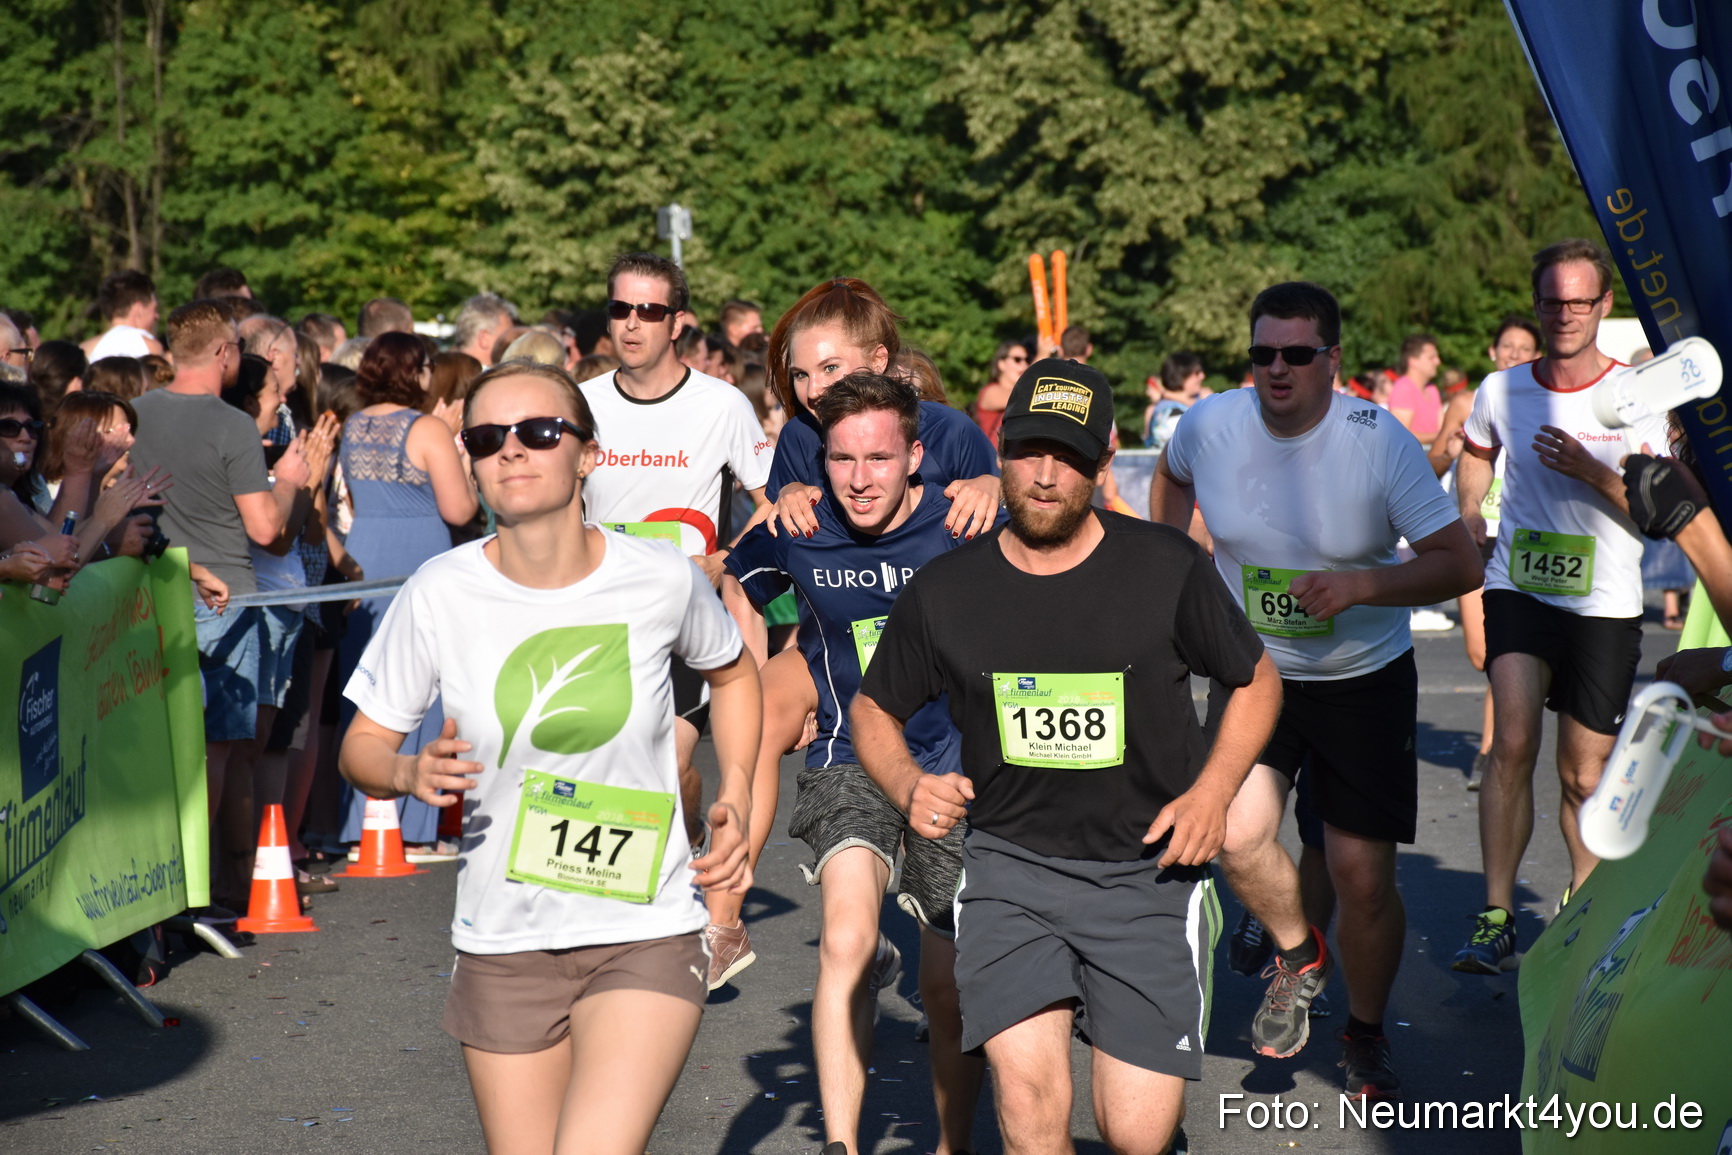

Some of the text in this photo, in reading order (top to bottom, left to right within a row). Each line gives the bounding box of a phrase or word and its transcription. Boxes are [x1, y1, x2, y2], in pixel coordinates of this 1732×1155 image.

[1034, 391, 1089, 405] INDUSTRY
[1054, 384, 1089, 396] EQUIPMENT
[1051, 402, 1086, 414] LEADING
[1346, 413, 1378, 430] adidas
[1577, 431, 1623, 442] Oberbank
[1520, 551, 1583, 578] 1452
[813, 568, 878, 588] EURO
[1283, 618, 1307, 626] Stefan
[1010, 688, 1053, 697] firmenlauf
[1012, 707, 1106, 741] 1368
[1028, 742, 1092, 752] Klein Michael
[5, 733, 87, 884] firmenlauf
[541, 791, 594, 810] firmenlauf
[550, 819, 634, 866] 147
[546, 858, 622, 880] Priess Melina
[557, 873, 595, 886] Bionorica
[595, 879, 607, 888] SE
